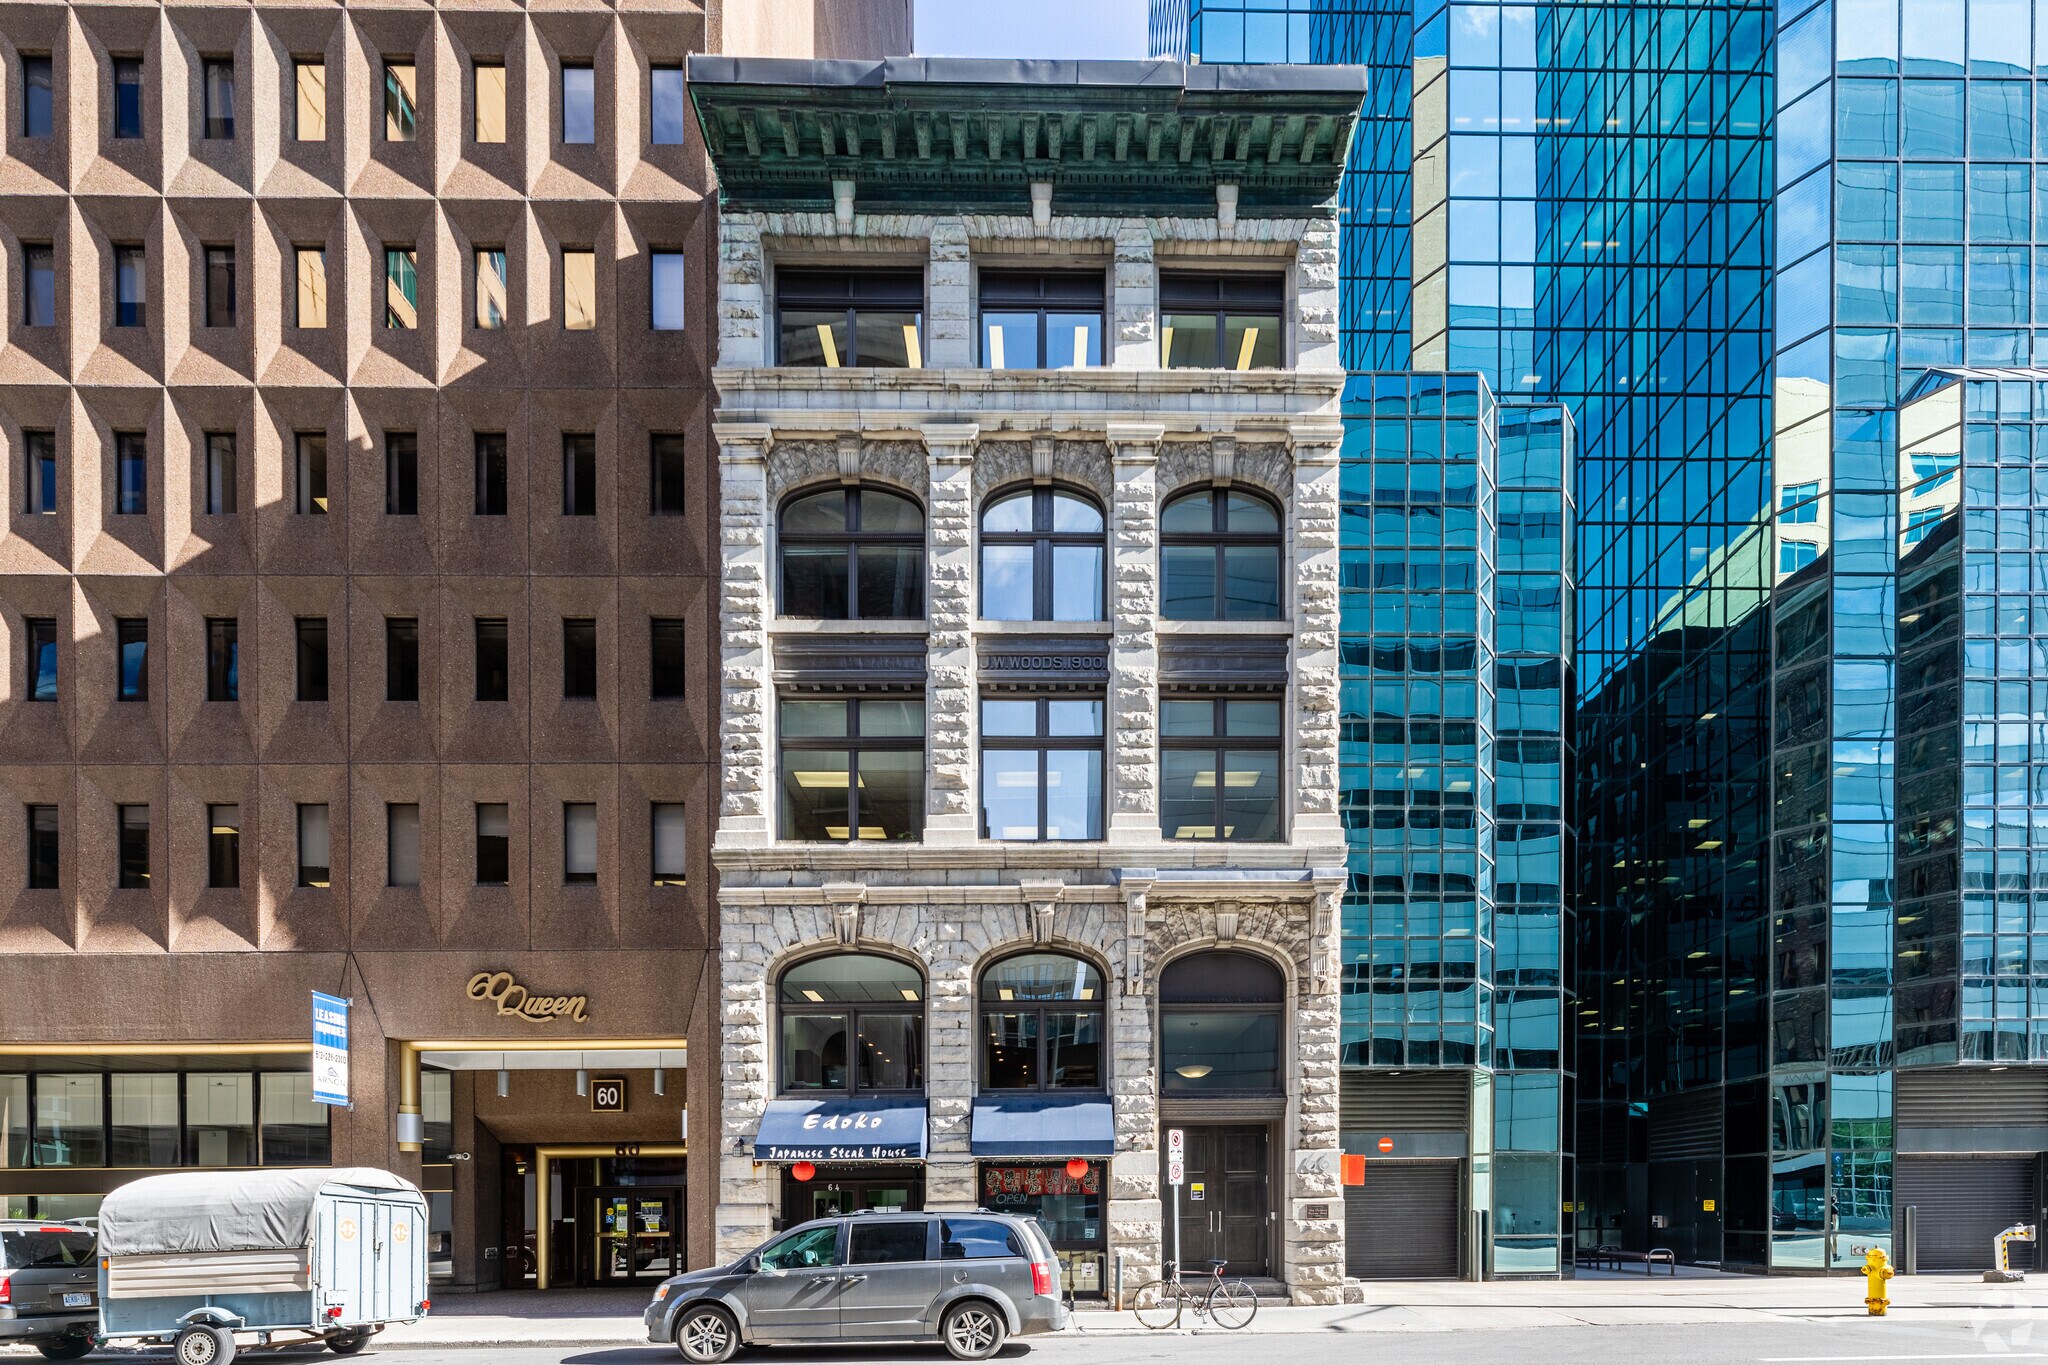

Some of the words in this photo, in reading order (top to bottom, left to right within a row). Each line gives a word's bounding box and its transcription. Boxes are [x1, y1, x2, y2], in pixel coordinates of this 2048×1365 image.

[466, 971, 514, 1001] 60
[497, 985, 588, 1023] Queen
[315, 1007, 346, 1027] LEASING
[597, 1087, 618, 1106] 60
[803, 1113, 882, 1130] Edoko
[769, 1146, 823, 1159] Japanese
[830, 1146, 865, 1159] Steak
[872, 1146, 907, 1158] House
[828, 1184, 840, 1192] 64
[996, 1194, 1028, 1204] OPEN
